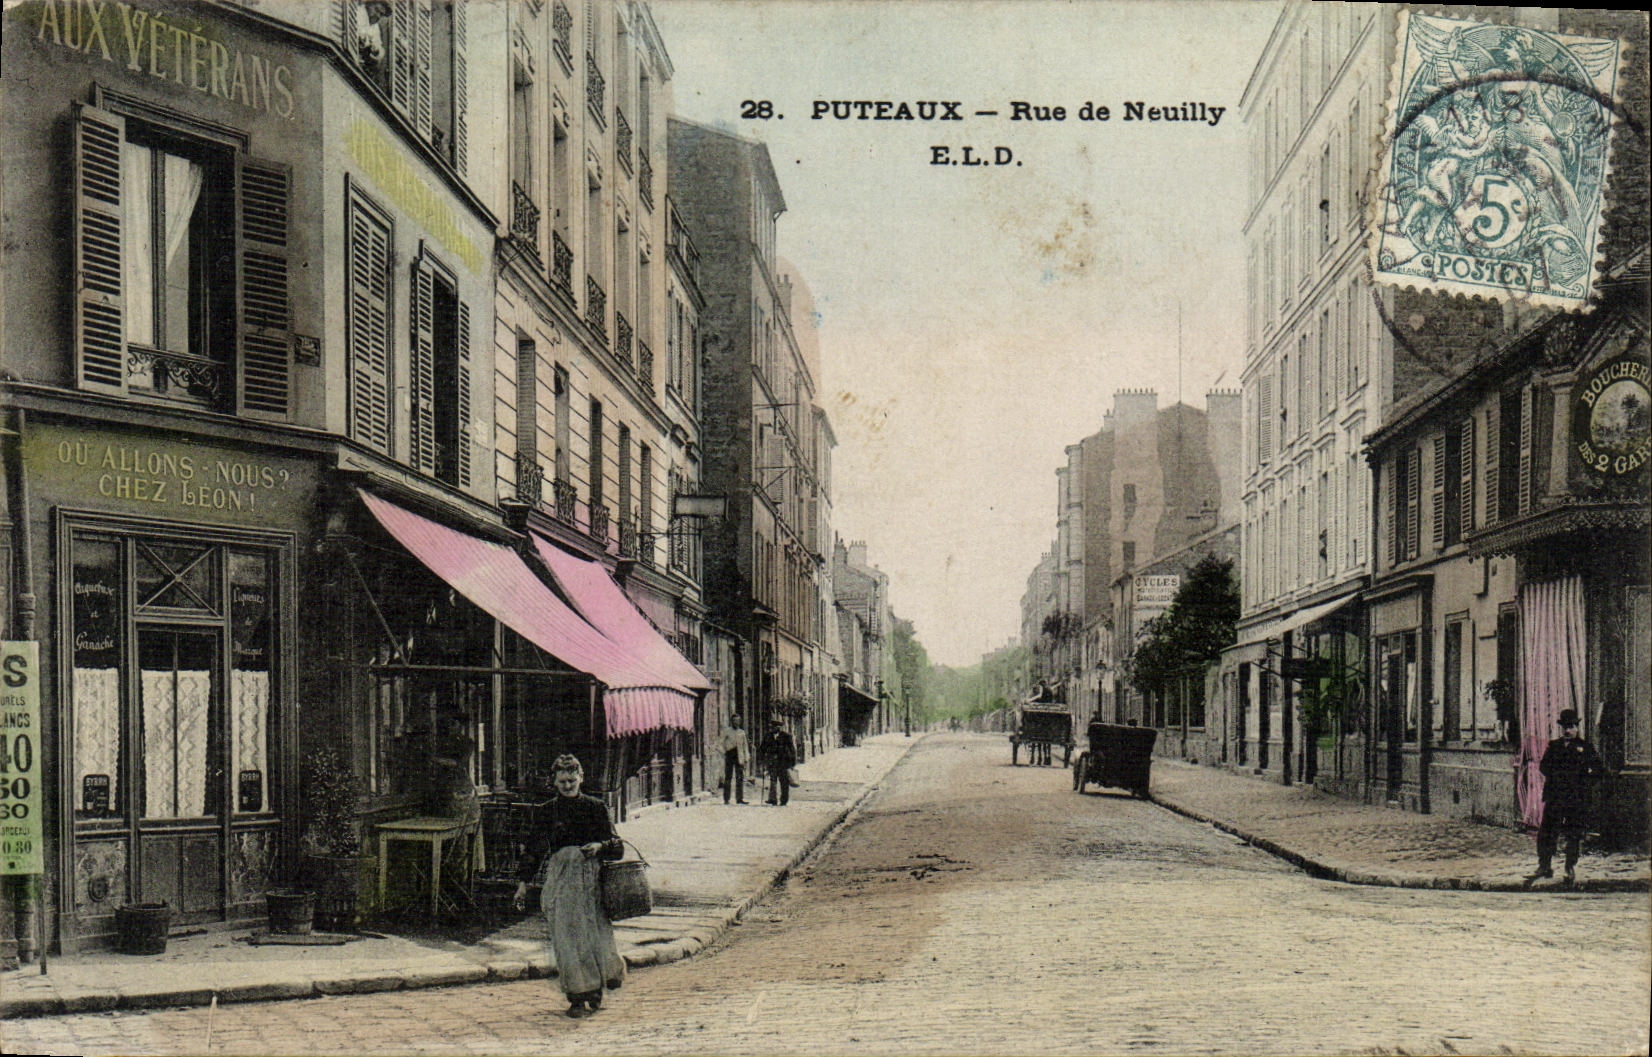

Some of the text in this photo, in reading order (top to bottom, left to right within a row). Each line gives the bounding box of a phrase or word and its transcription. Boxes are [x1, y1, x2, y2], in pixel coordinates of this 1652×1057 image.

[38, 0, 294, 118] AUX VÉTÉRANS
[1438, 254, 1528, 287] POSTES
[58, 438, 88, 466] OÙ
[101, 446, 194, 480] ALLONS
[1579, 441, 1596, 465] DES
[1595, 454, 1609, 472] 2
[99, 474, 168, 503] CHEZ
[1134, 577, 1178, 588] CYCLES
[74, 631, 114, 651] Ganache
[3, 654, 28, 688] S
